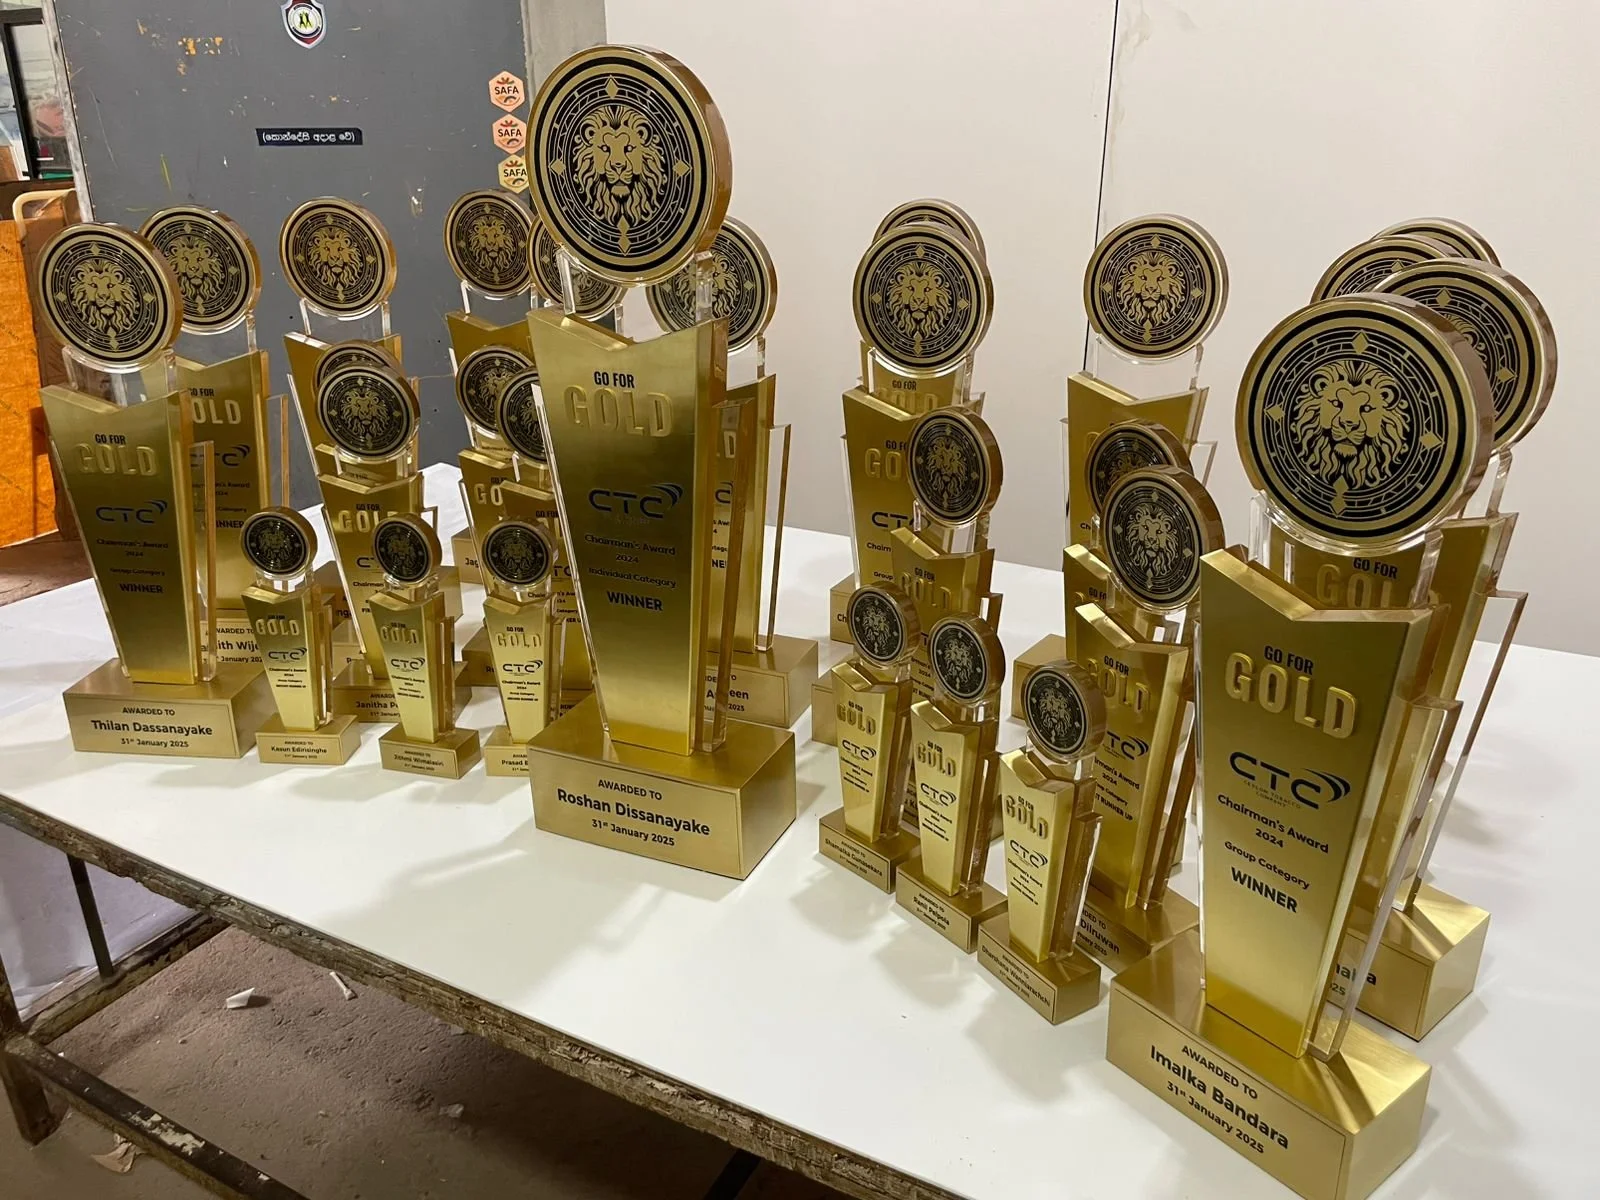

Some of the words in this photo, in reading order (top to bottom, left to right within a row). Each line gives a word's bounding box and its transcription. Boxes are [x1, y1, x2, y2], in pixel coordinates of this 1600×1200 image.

[494, 86, 520, 95] SAFA
[497, 129, 522, 138] SAFA
[503, 168, 527, 178] SAFA
[593, 371, 610, 386] GO
[613, 372, 635, 389] FOR
[892, 380, 902, 390] GO
[904, 380, 917, 391] FOR
[200, 387, 214, 397] FOR
[192, 398, 241, 425] OLD
[563, 385, 674, 438] GOLD
[95, 433, 107, 444] GO
[109, 434, 126, 445] FOR
[885, 440, 897, 451] GO
[75, 443, 160, 476] GOLD
[865, 448, 904, 483] GO
[474, 483, 504, 507] GO
[588, 486, 677, 519] CTC
[96, 502, 163, 523] CTC
[215, 519, 247, 530] INNER
[584, 534, 641, 551] Chairman's
[642, 540, 675, 556] Award
[614, 553, 638, 564] 2024
[1353, 557, 1371, 572] GO
[1374, 561, 1398, 580] FOR
[120, 583, 164, 594] WINNER
[588, 566, 632, 581] Individual
[633, 573, 676, 589] Category
[606, 590, 663, 612] WINNER
[255, 618, 300, 636] GOLD
[497, 632, 542, 648] GOLD
[268, 649, 305, 661] CTC
[391, 658, 423, 671] CTC
[1103, 655, 1114, 668] GO
[1115, 660, 1130, 677] FOR
[1264, 645, 1283, 665] GO
[1285, 652, 1314, 676] FOR
[503, 662, 540, 673] CTC
[355, 701, 388, 709] Janitha
[1224, 651, 1357, 740] GOLD
[122, 707, 163, 716] AWARDED
[164, 708, 176, 716] TO
[837, 703, 877, 736] GOLD
[91, 720, 130, 732] Thilan
[133, 721, 213, 737] Dassanayake
[137, 738, 169, 748] January
[170, 740, 190, 748] 2025
[842, 740, 874, 761] CTC
[1107, 731, 1142, 762] TC
[916, 742, 957, 778] GOLD
[598, 779, 647, 797] AWARDED
[649, 790, 662, 801] TO
[1102, 773, 1118, 787] 2024
[1117, 772, 1140, 791] Award
[1229, 752, 1342, 810] CTC
[921, 784, 953, 807] CTC
[557, 788, 611, 813] Roshan
[615, 802, 711, 836] Dissanayake
[1005, 795, 1049, 840] GOLD
[1217, 793, 1286, 833] Chairman's
[1287, 827, 1329, 854] Award
[610, 824, 650, 841] January
[652, 833, 676, 847] 2025
[1255, 829, 1284, 849] 2024
[1010, 841, 1045, 869] CTC
[1224, 840, 1256, 863] Group
[1258, 857, 1310, 890] Category
[1231, 866, 1298, 913] WINNER
[1098, 919, 1107, 930] TO
[1080, 918, 1120, 955] Dilruwan
[1181, 1045, 1239, 1088] AWARDED
[1241, 1082, 1258, 1100] TO
[1150, 1044, 1207, 1095] Imalka
[1212, 1086, 1289, 1150] Bandara
[1188, 1095, 1233, 1134] January
[1235, 1128, 1265, 1154] 2025
